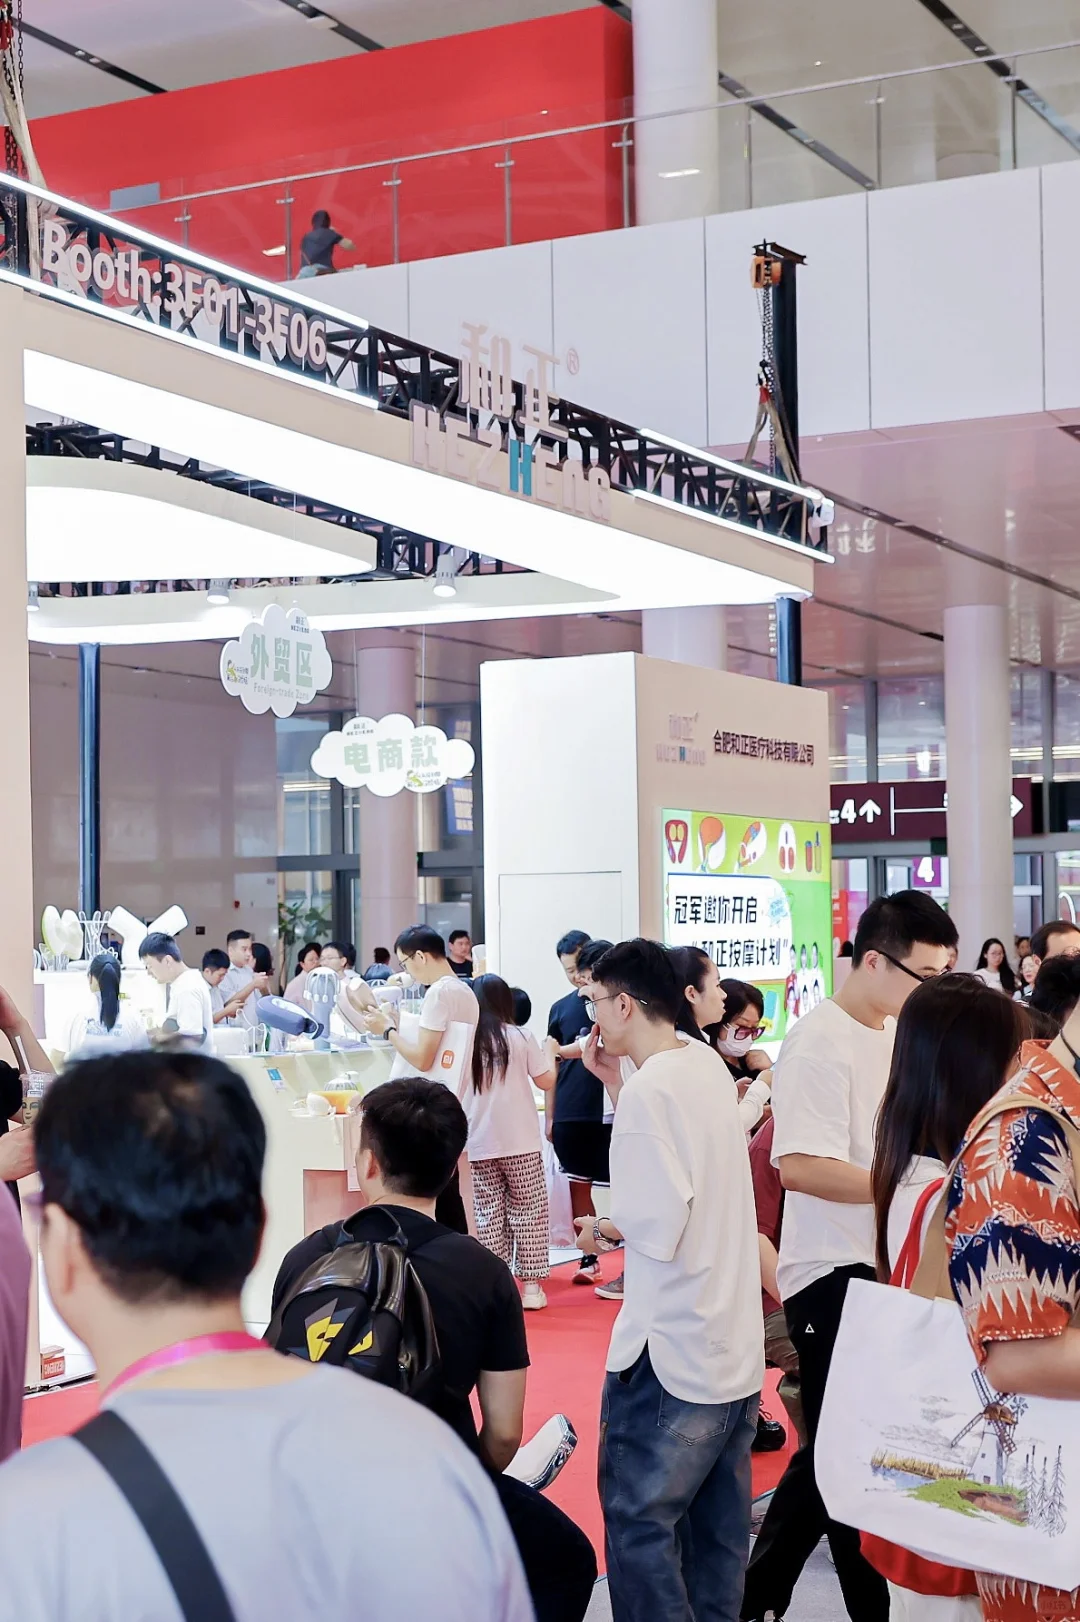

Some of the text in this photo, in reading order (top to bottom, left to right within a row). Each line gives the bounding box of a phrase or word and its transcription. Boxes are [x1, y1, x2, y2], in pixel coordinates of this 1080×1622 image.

[250, 633, 313, 688] 外贸区
[343, 734, 439, 774] 电商款
[713, 729, 815, 766] 合肥和正医疗科技有限公司
[674, 895, 758, 924] 冠军邀你开启
